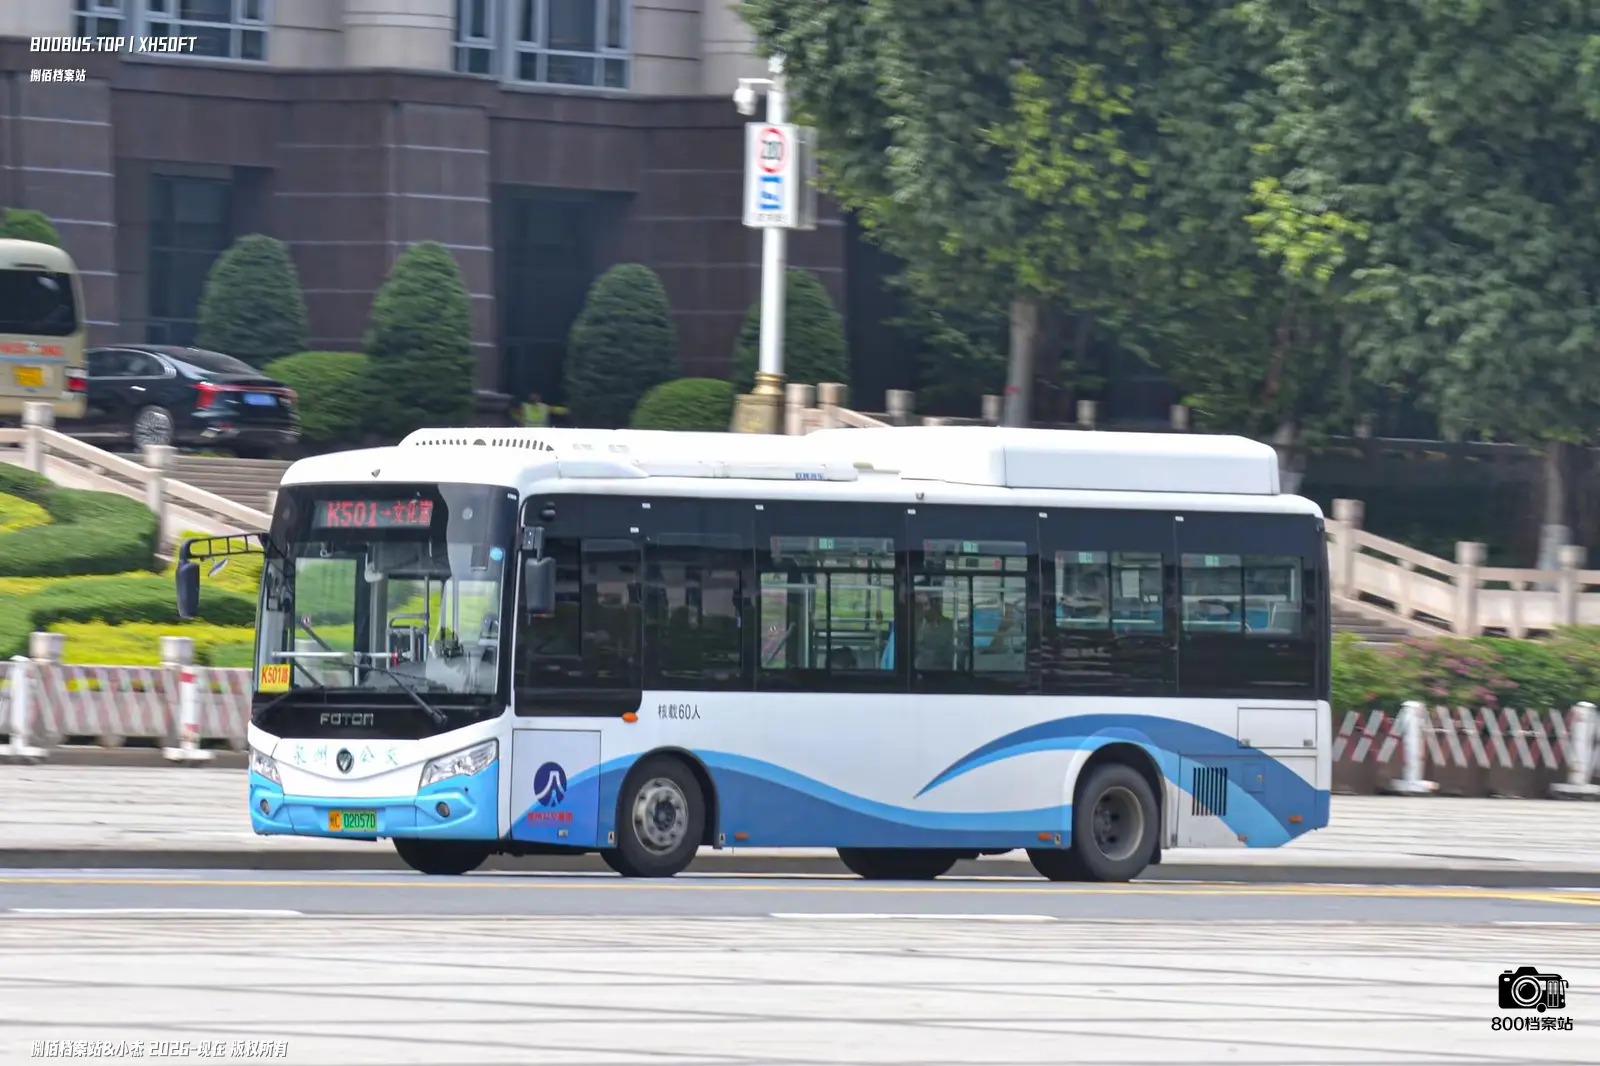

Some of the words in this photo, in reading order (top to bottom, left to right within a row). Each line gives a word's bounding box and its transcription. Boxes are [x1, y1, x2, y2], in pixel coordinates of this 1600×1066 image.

[326, 500, 377, 528] K501
[320, 712, 374, 726] FOTON
[658, 703, 701, 721] 核载60人
